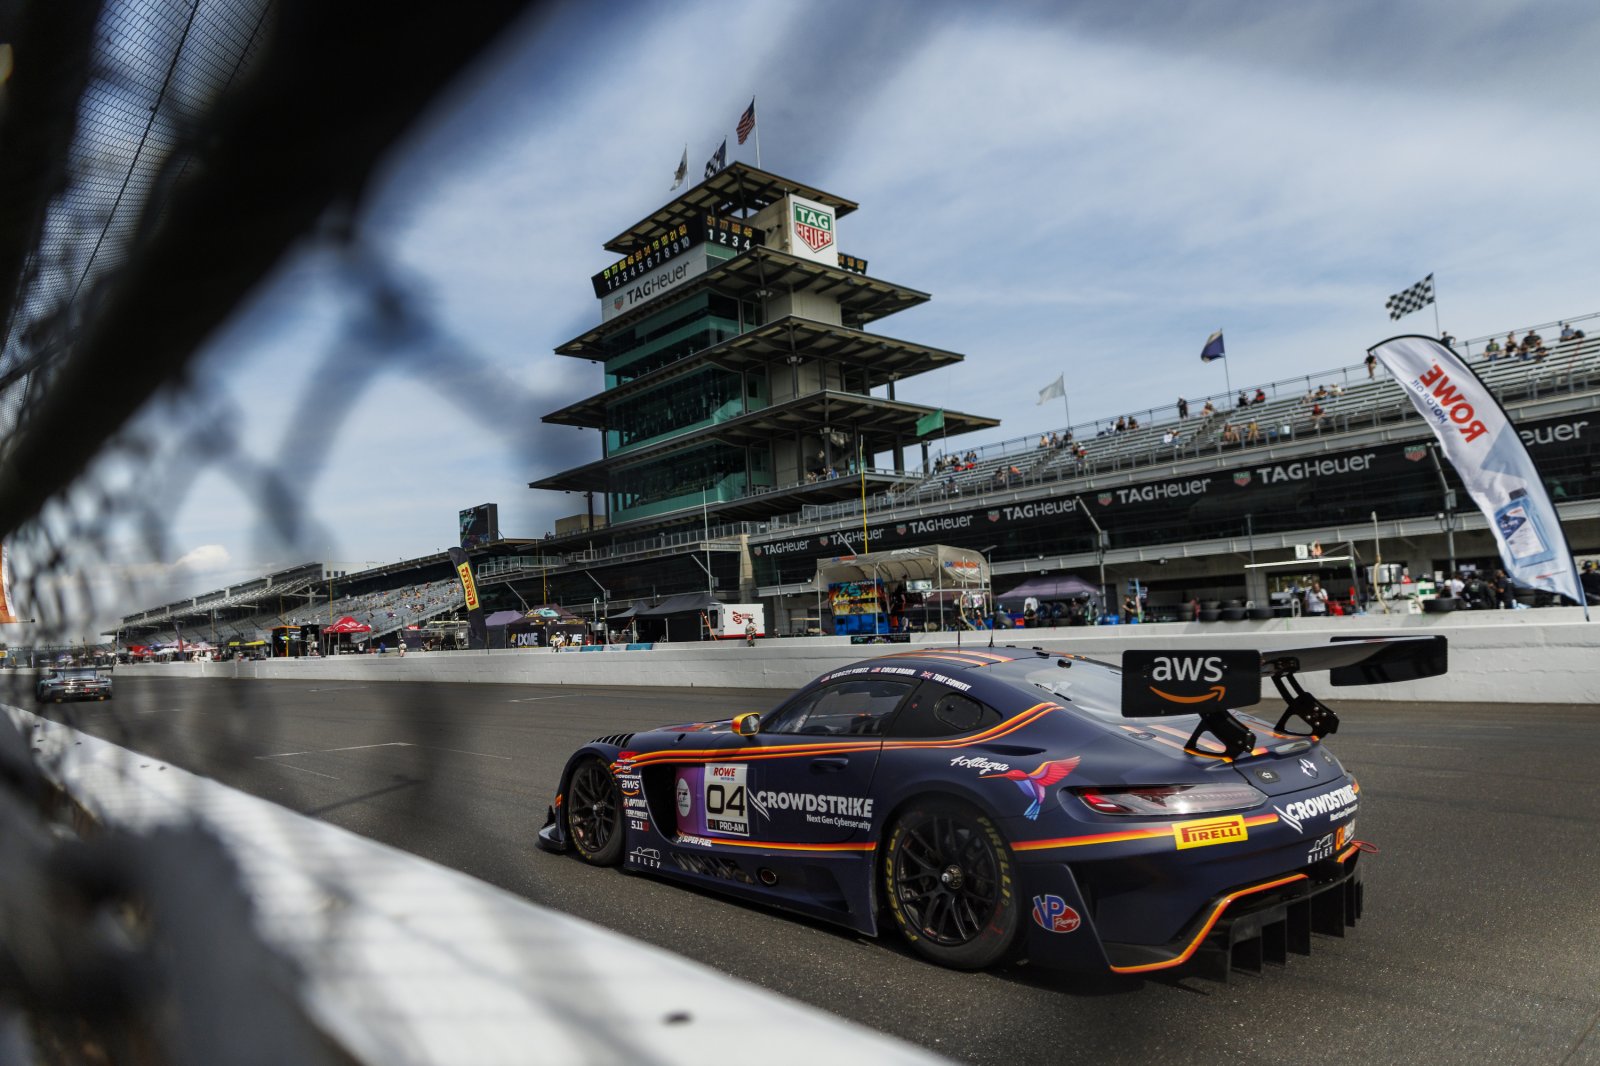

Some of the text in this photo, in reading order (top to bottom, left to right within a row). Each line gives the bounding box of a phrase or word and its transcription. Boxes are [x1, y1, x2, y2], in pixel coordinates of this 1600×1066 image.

[797, 207, 829, 230] TAG
[708, 229, 750, 250] 1 2 3 4
[796, 223, 832, 250] HEUER
[607, 236, 690, 290] 1 2 3 4 5 6 7 8 9 10
[627, 261, 690, 304] TAGHeuer
[1520, 421, 1589, 446] euer
[1256, 452, 1376, 484] TAGHeuer
[1116, 478, 1211, 504] TAGHeuer
[1003, 498, 1079, 521] TAGHeuer
[909, 514, 973, 534] TAGHeuer
[763, 539, 810, 555] TAGHeuer
[830, 528, 884, 546] TAGHeuer
[1152, 656, 1223, 682] aws
[932, 672, 972, 692] TOBY SOWERY
[713, 767, 736, 777] ROWE
[621, 780, 639, 789] aws
[707, 784, 745, 816] 04
[756, 790, 874, 818] CROWDSTRIKE
[1286, 784, 1358, 821] CROWDSTRIKE
[719, 821, 744, 832] PRO-AM
[806, 814, 871, 832] Next Gen Cybersecurity
[1181, 821, 1241, 842] PIRELLI
[682, 836, 712, 848] SUPER FUEL
[630, 855, 660, 868] RILEY
[1308, 845, 1333, 864] RILEY
[1032, 894, 1066, 929] VP
